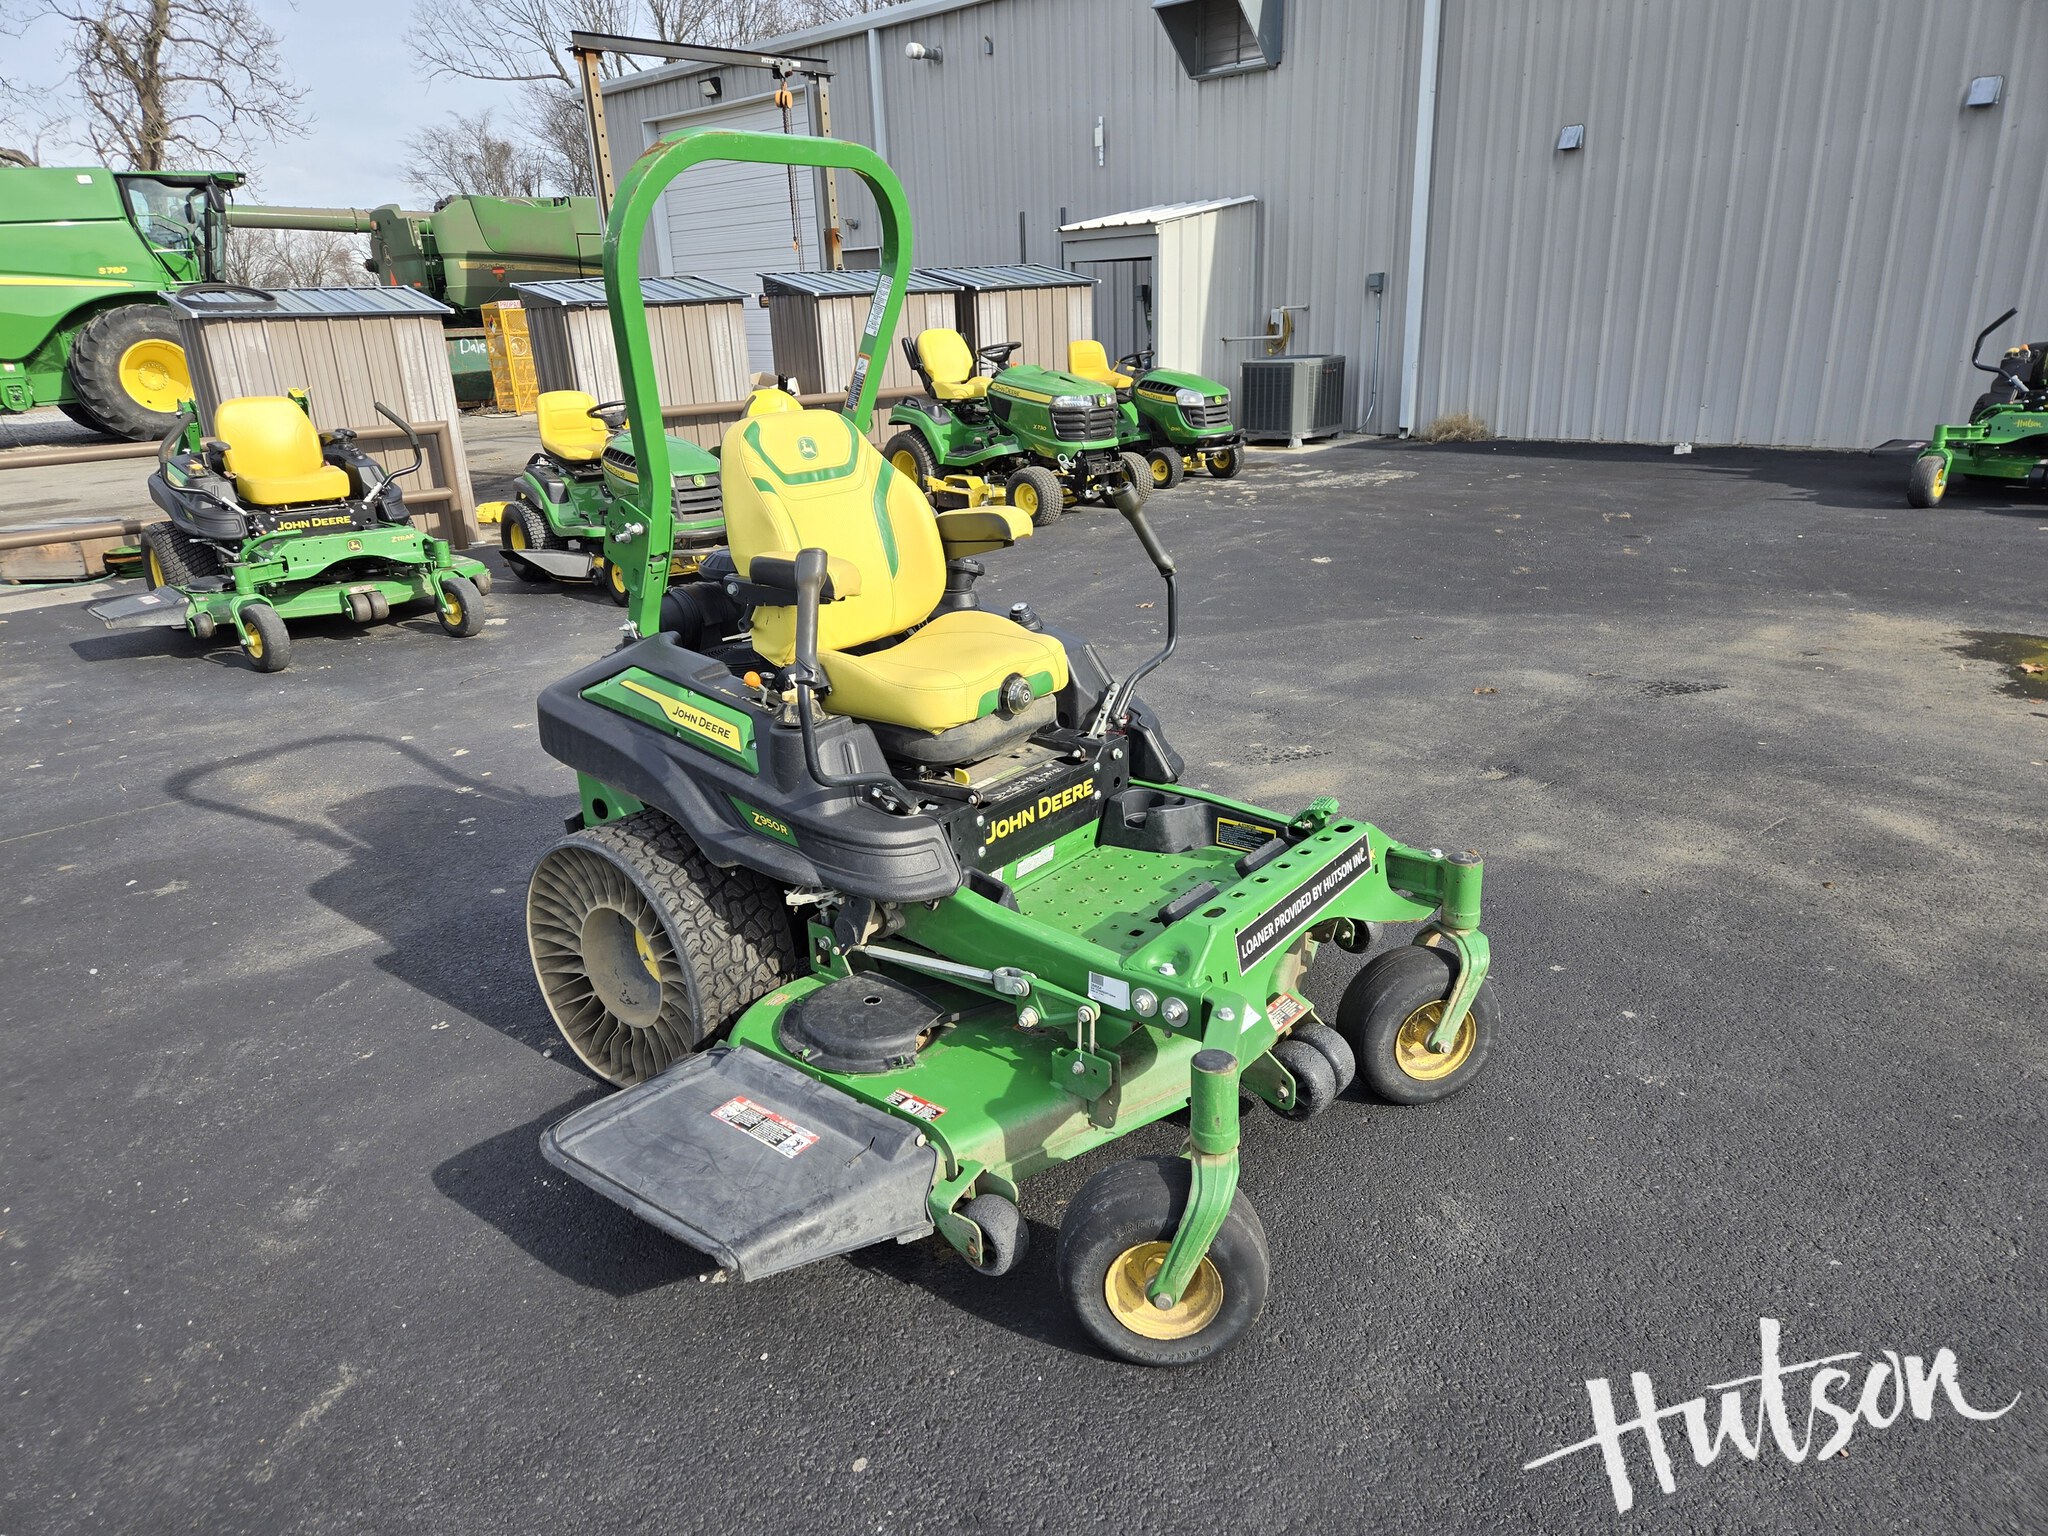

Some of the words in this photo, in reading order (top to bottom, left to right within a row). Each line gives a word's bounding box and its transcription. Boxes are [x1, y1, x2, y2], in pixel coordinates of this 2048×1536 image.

[277, 520, 310, 531] JOHN
[312, 515, 352, 527] DEERE
[391, 533, 415, 543] ZTRAK
[672, 706, 698, 725] JOHN
[699, 717, 731, 740] DEERE
[751, 811, 789, 836] Z950R
[985, 805, 1035, 845] JOHN
[1037, 777, 1095, 820] DEERE
[1241, 923, 1275, 959] LOANER
[1273, 894, 1312, 934] PROVIDED
[1311, 883, 1324, 901] BY
[1322, 859, 1354, 892] HUTSON
